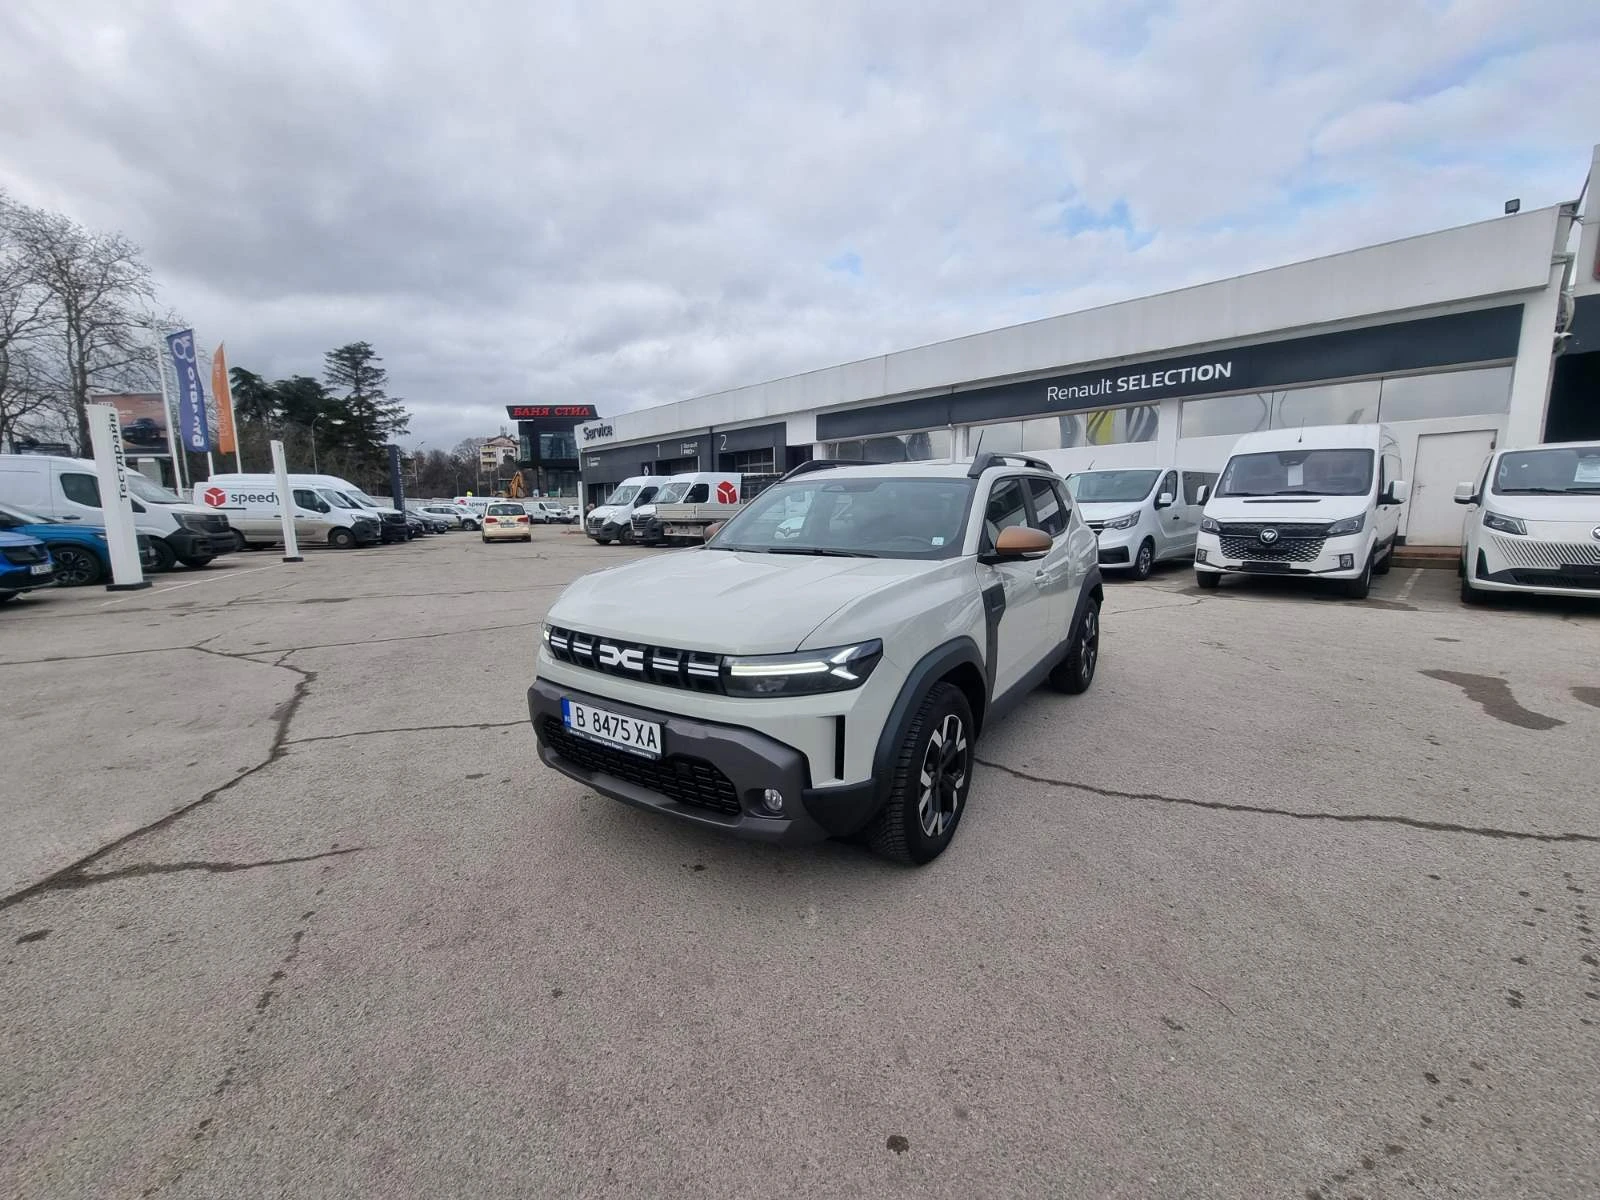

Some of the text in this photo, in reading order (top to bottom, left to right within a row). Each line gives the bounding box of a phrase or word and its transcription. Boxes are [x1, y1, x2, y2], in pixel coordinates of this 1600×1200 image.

[1047, 361, 1232, 402] Renault SELECTION
[513, 406, 590, 416] БАНЯ СТИЛ
[583, 423, 613, 441] Service
[656, 443, 661, 458] 1
[720, 434, 727, 451] 2
[109, 412, 128, 502] Тестдрайв
[231, 491, 280, 506] speedy
[576, 706, 586, 728] B
[592, 711, 631, 742] 8475
[634, 721, 657, 750] XA
